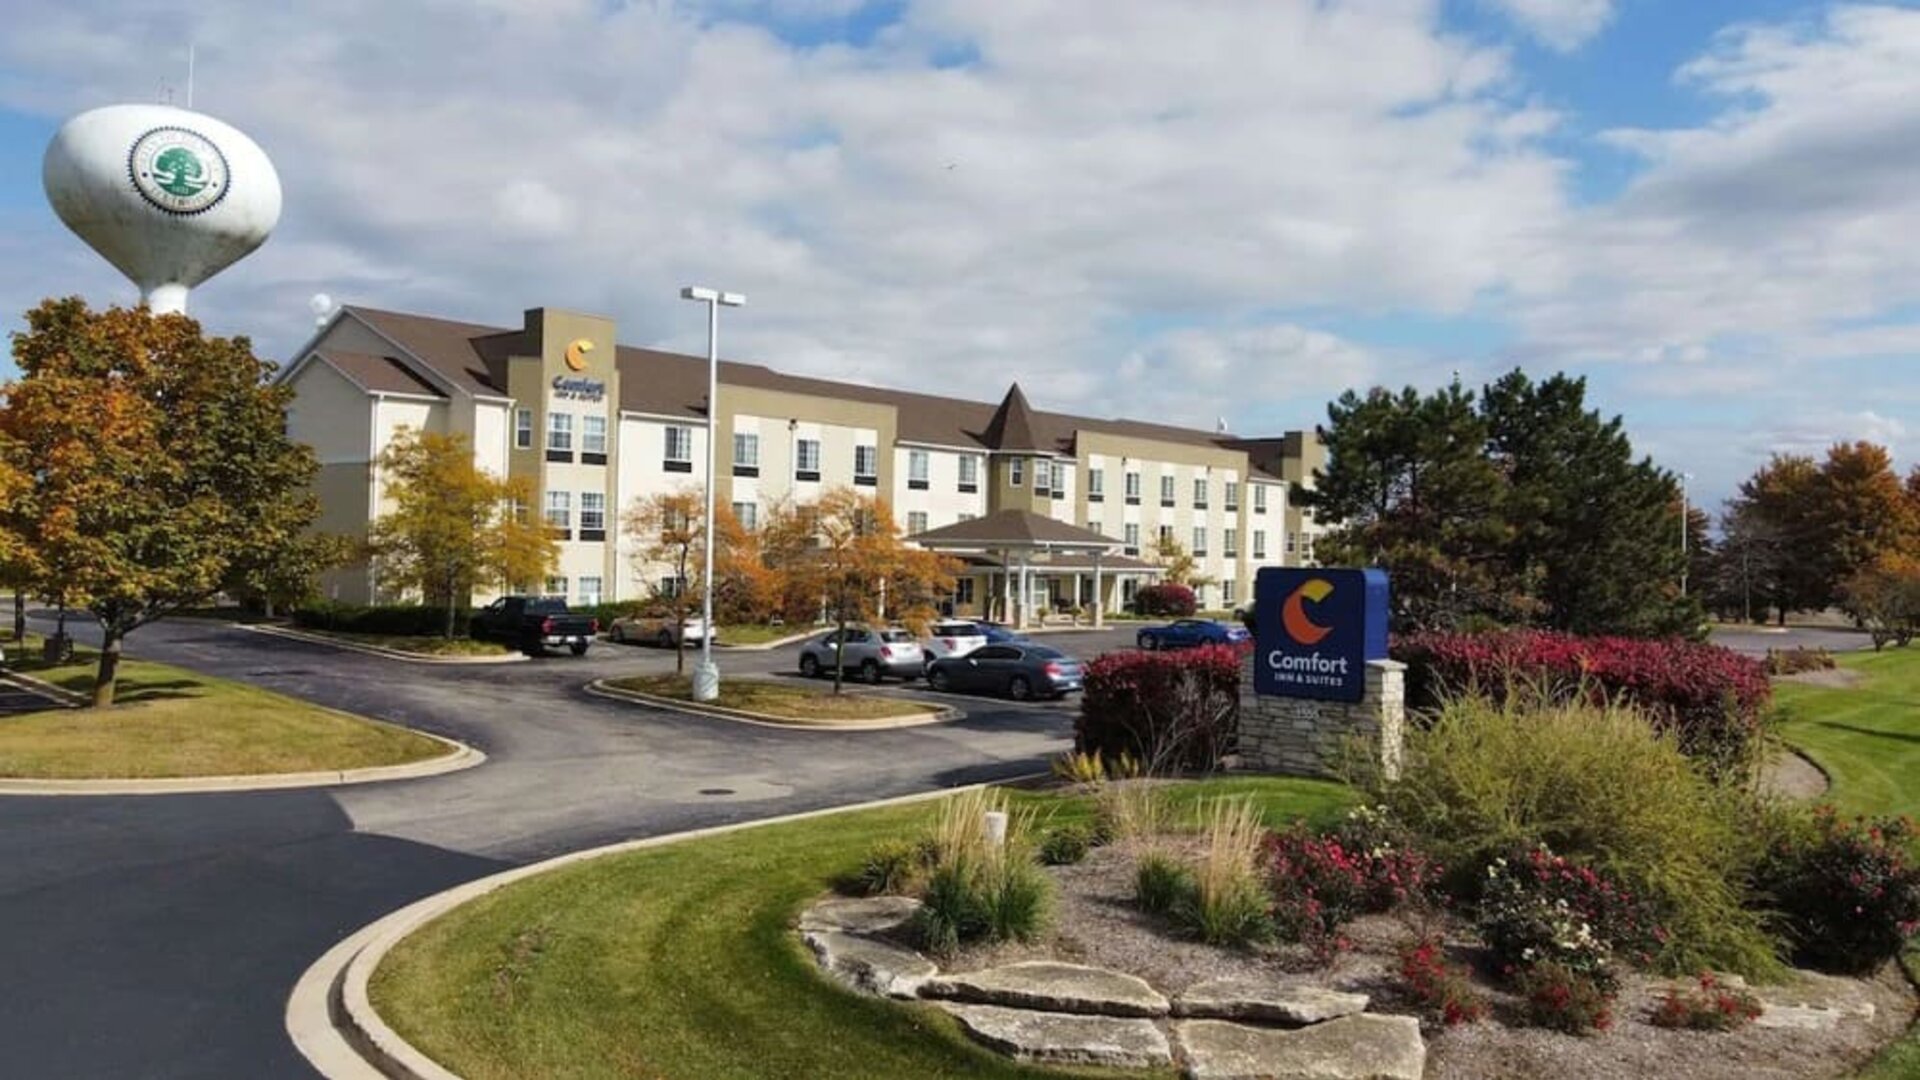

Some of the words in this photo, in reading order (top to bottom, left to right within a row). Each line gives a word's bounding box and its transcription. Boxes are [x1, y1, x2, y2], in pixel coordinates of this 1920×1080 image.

[551, 376, 605, 395] Comfort
[1268, 650, 1348, 674] Comfort
[1274, 672, 1295, 682] INN
[1305, 674, 1344, 686] SUITES
